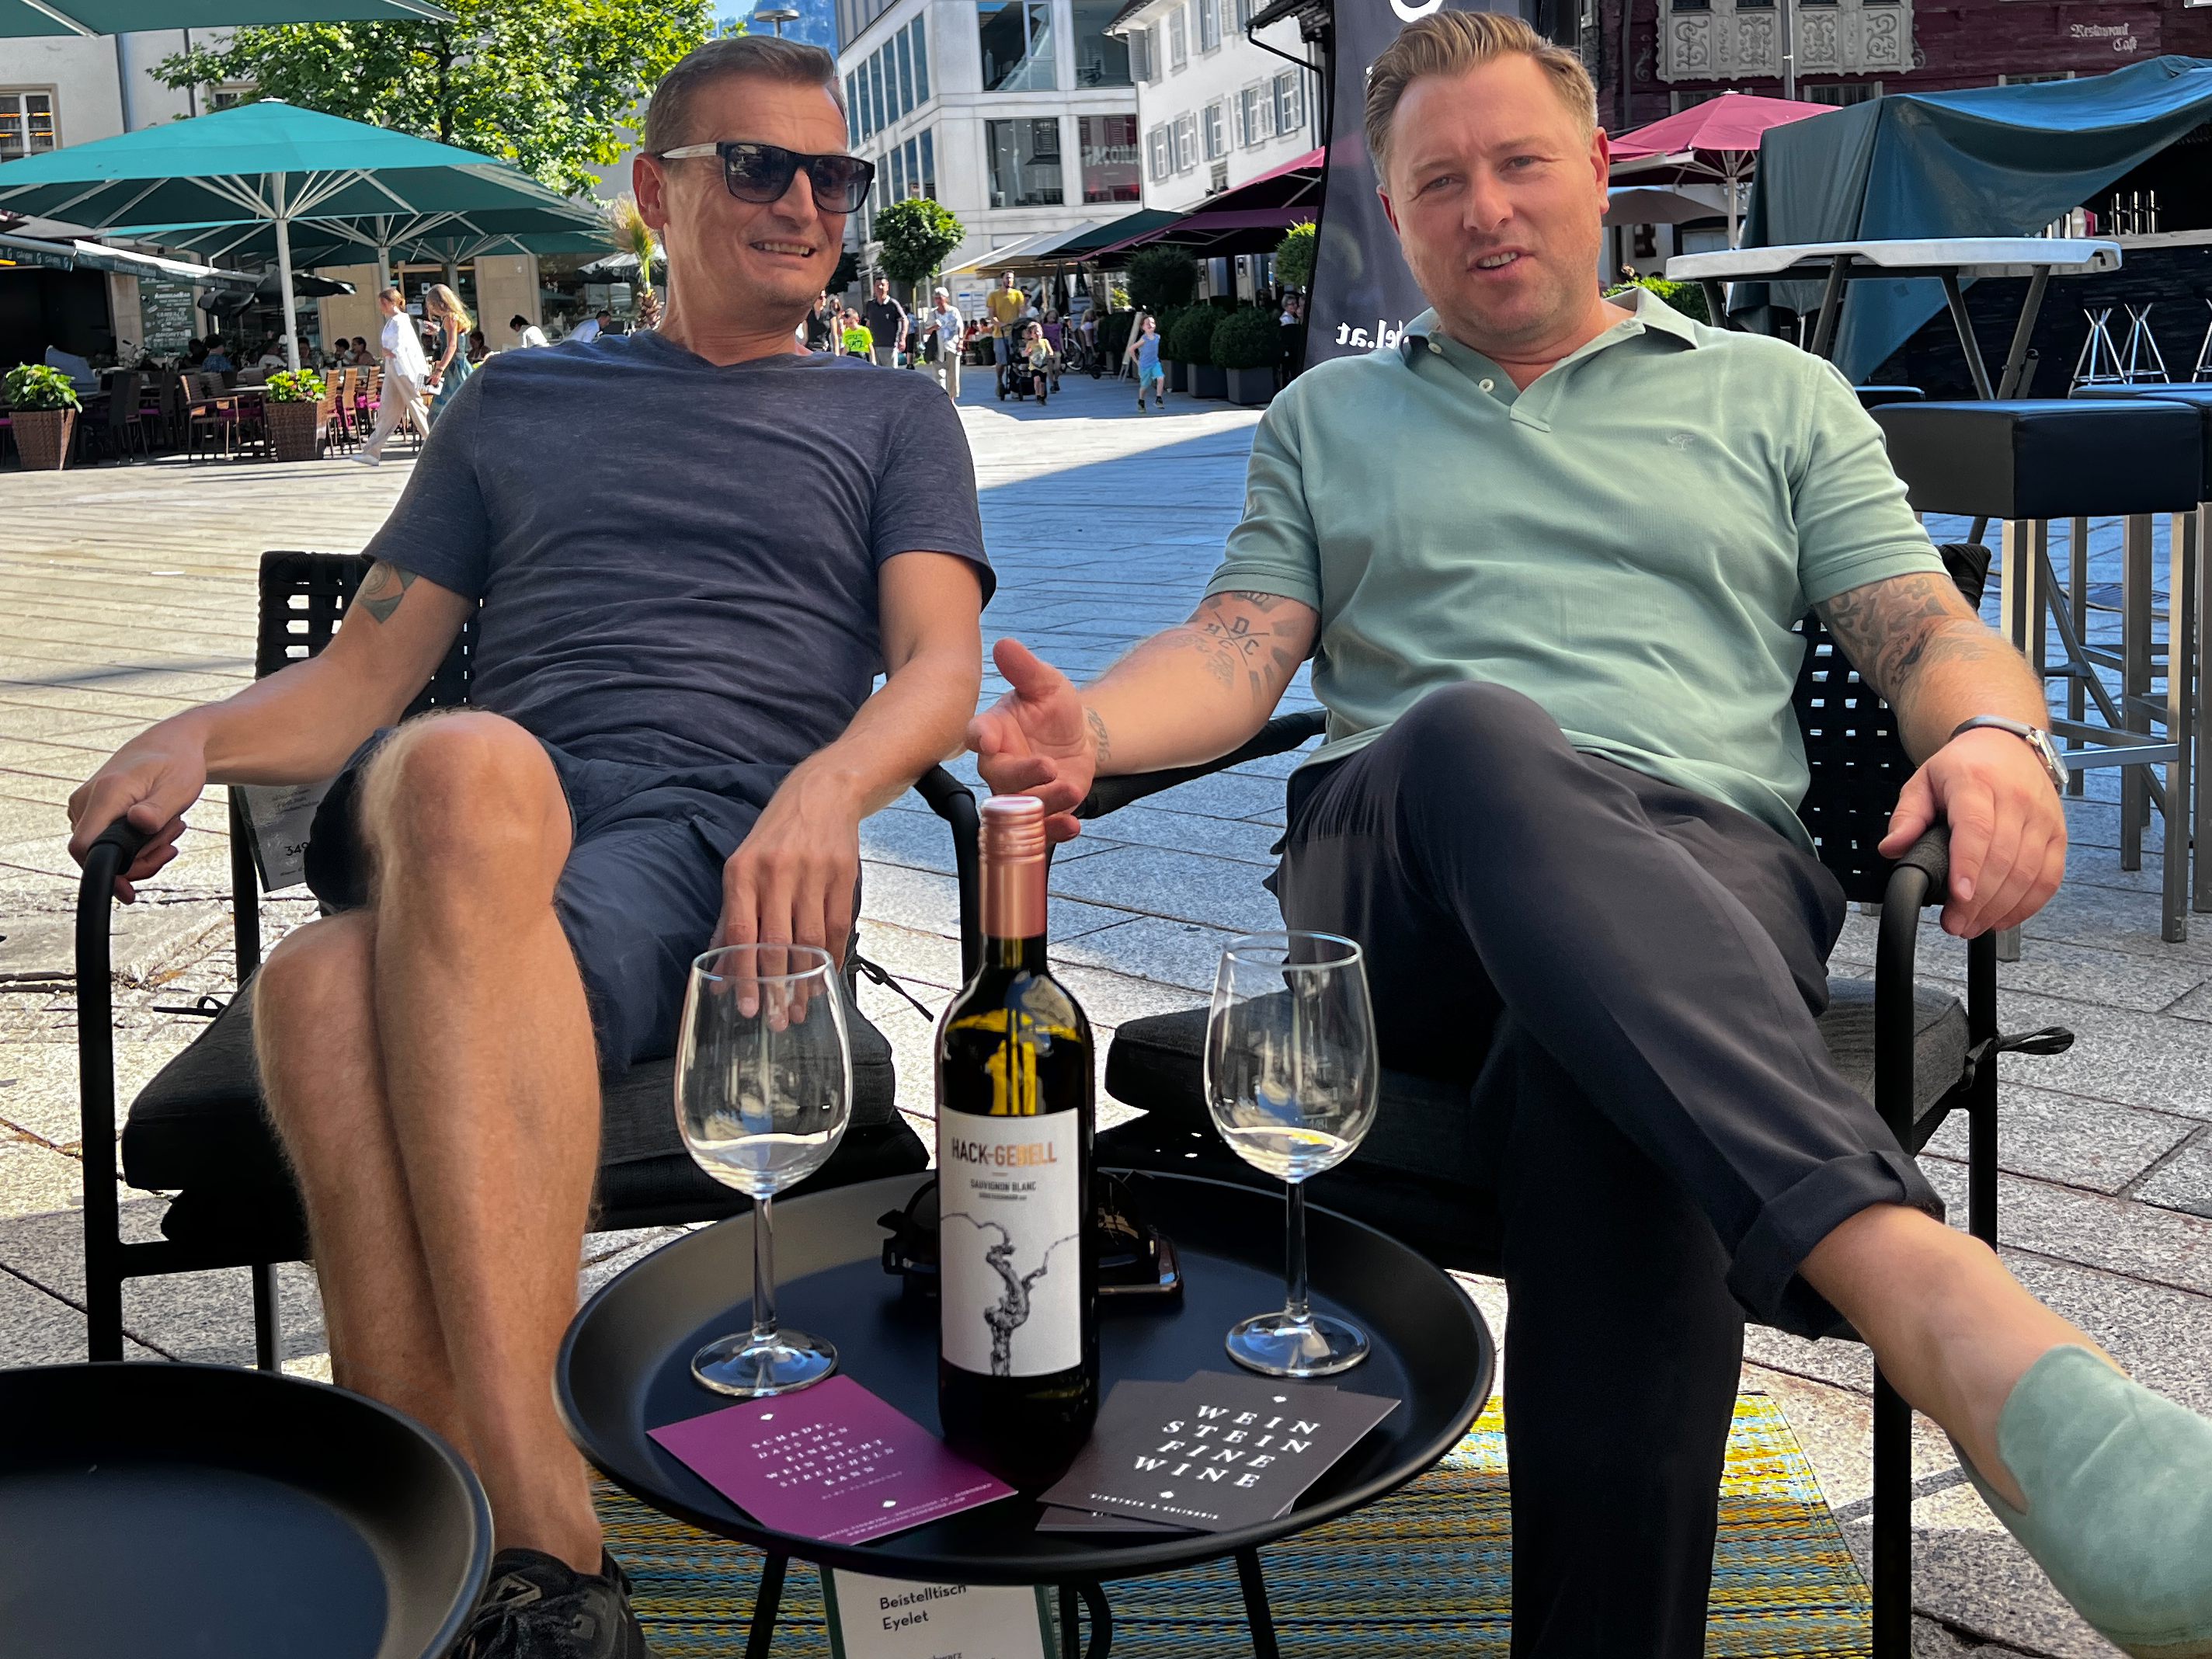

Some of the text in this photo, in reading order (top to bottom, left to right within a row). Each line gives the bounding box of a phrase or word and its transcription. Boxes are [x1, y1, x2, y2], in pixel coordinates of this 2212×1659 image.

[2070, 23, 2130, 37] Restaurant
[970, 1180, 1037, 1194] SAUVIGNON BLANC
[1197, 1404, 1321, 1435] WEIN
[1162, 1420, 1313, 1454] STEIN
[1156, 1440, 1277, 1468] FINE
[1132, 1456, 1261, 1488] WINE
[879, 1584, 967, 1610] Beistelltisch
[882, 1610, 930, 1632] Eyelet
